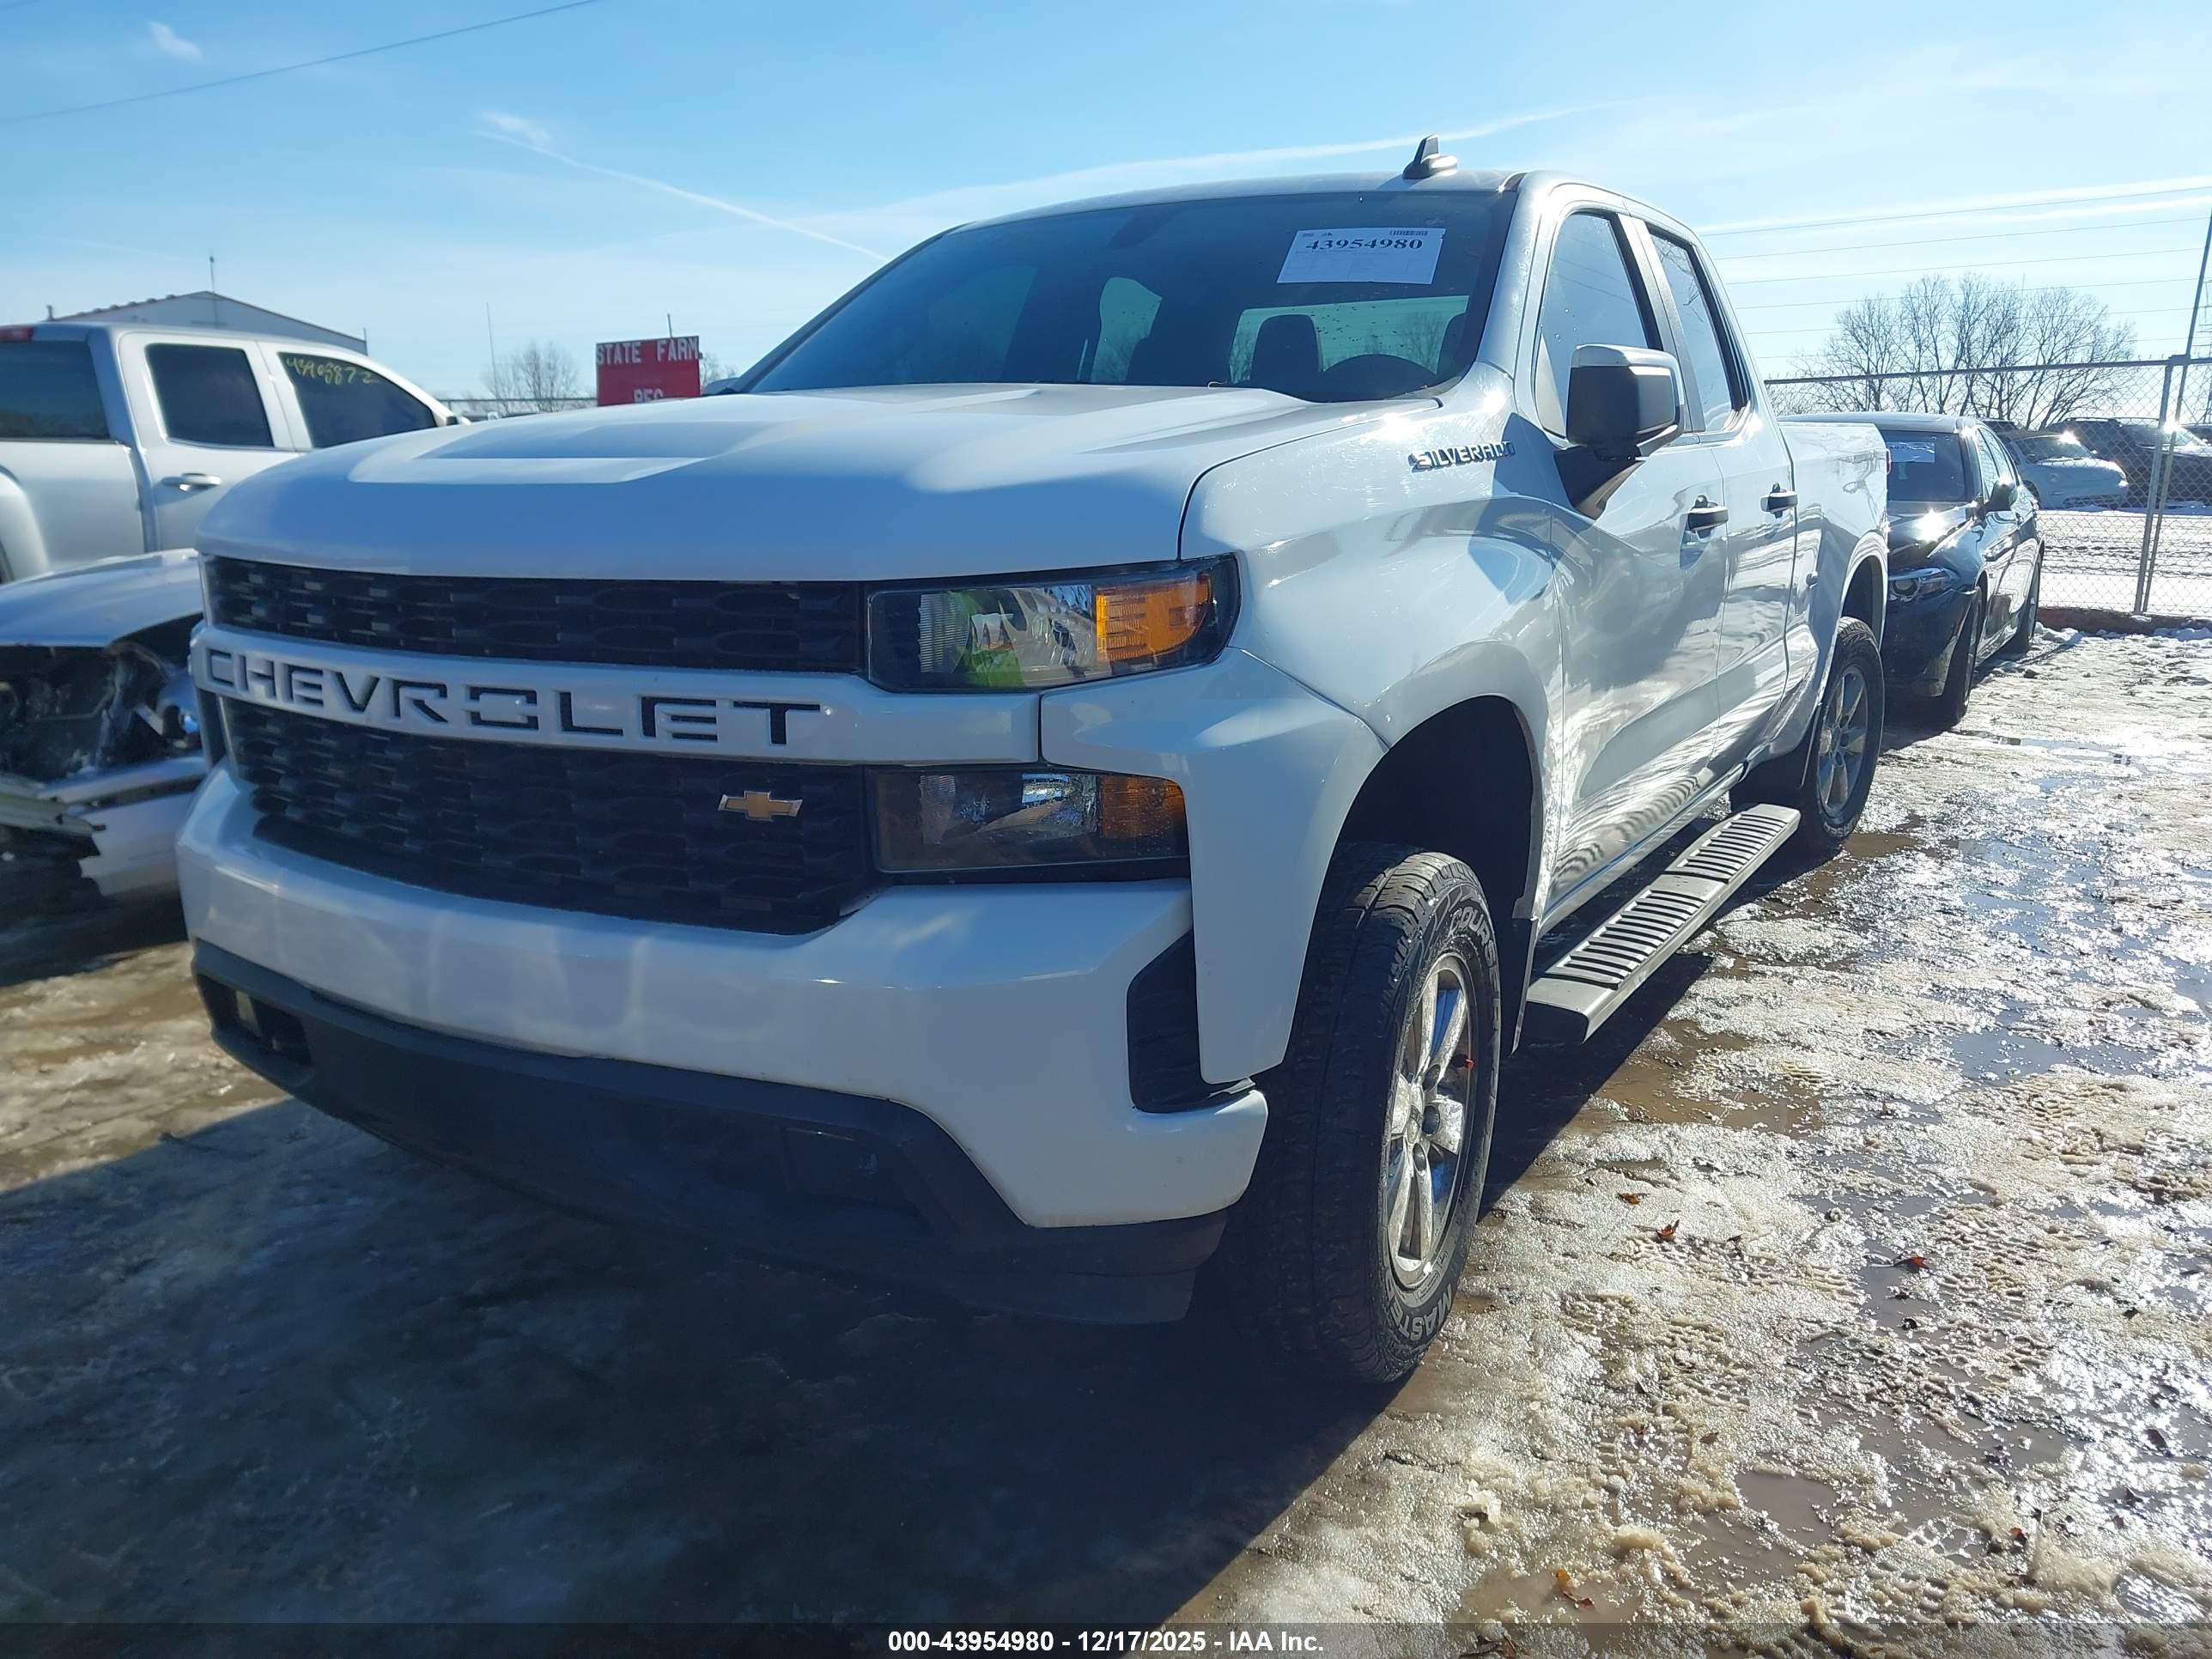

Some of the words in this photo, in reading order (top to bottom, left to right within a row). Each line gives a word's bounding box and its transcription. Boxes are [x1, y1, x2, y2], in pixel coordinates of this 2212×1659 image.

[1305, 238, 1423, 251] 43954980
[596, 341, 642, 366] STATE
[656, 337, 699, 362] FARM
[204, 648, 821, 746] CHEVROLET
